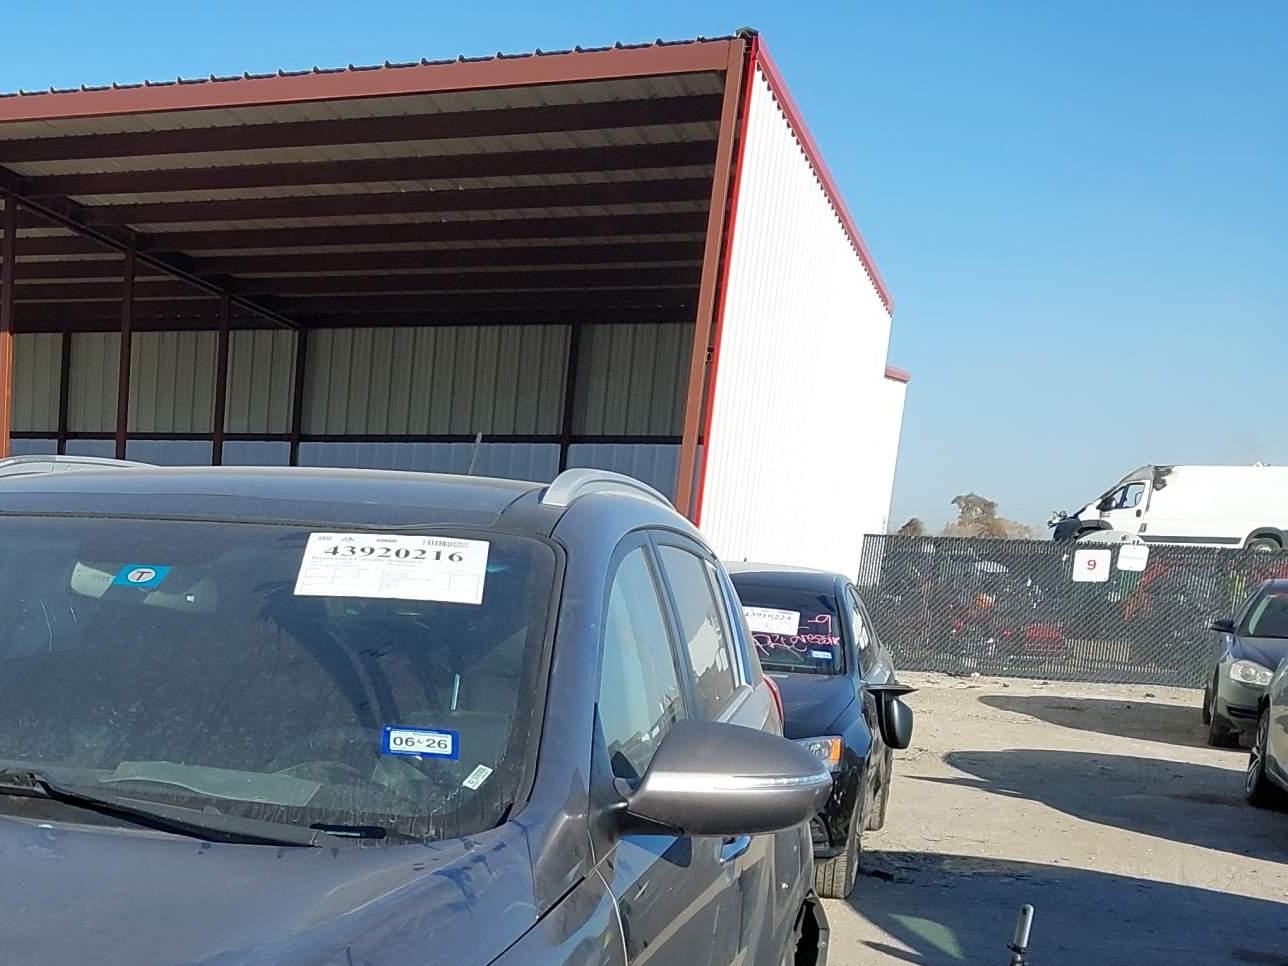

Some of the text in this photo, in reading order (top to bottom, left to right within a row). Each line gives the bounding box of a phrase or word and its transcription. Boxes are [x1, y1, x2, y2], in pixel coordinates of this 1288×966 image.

[323, 545, 463, 562] 43920216
[1086, 559, 1098, 571] 9
[136, 571, 152, 580] T
[393, 736, 448, 750] 06 26
